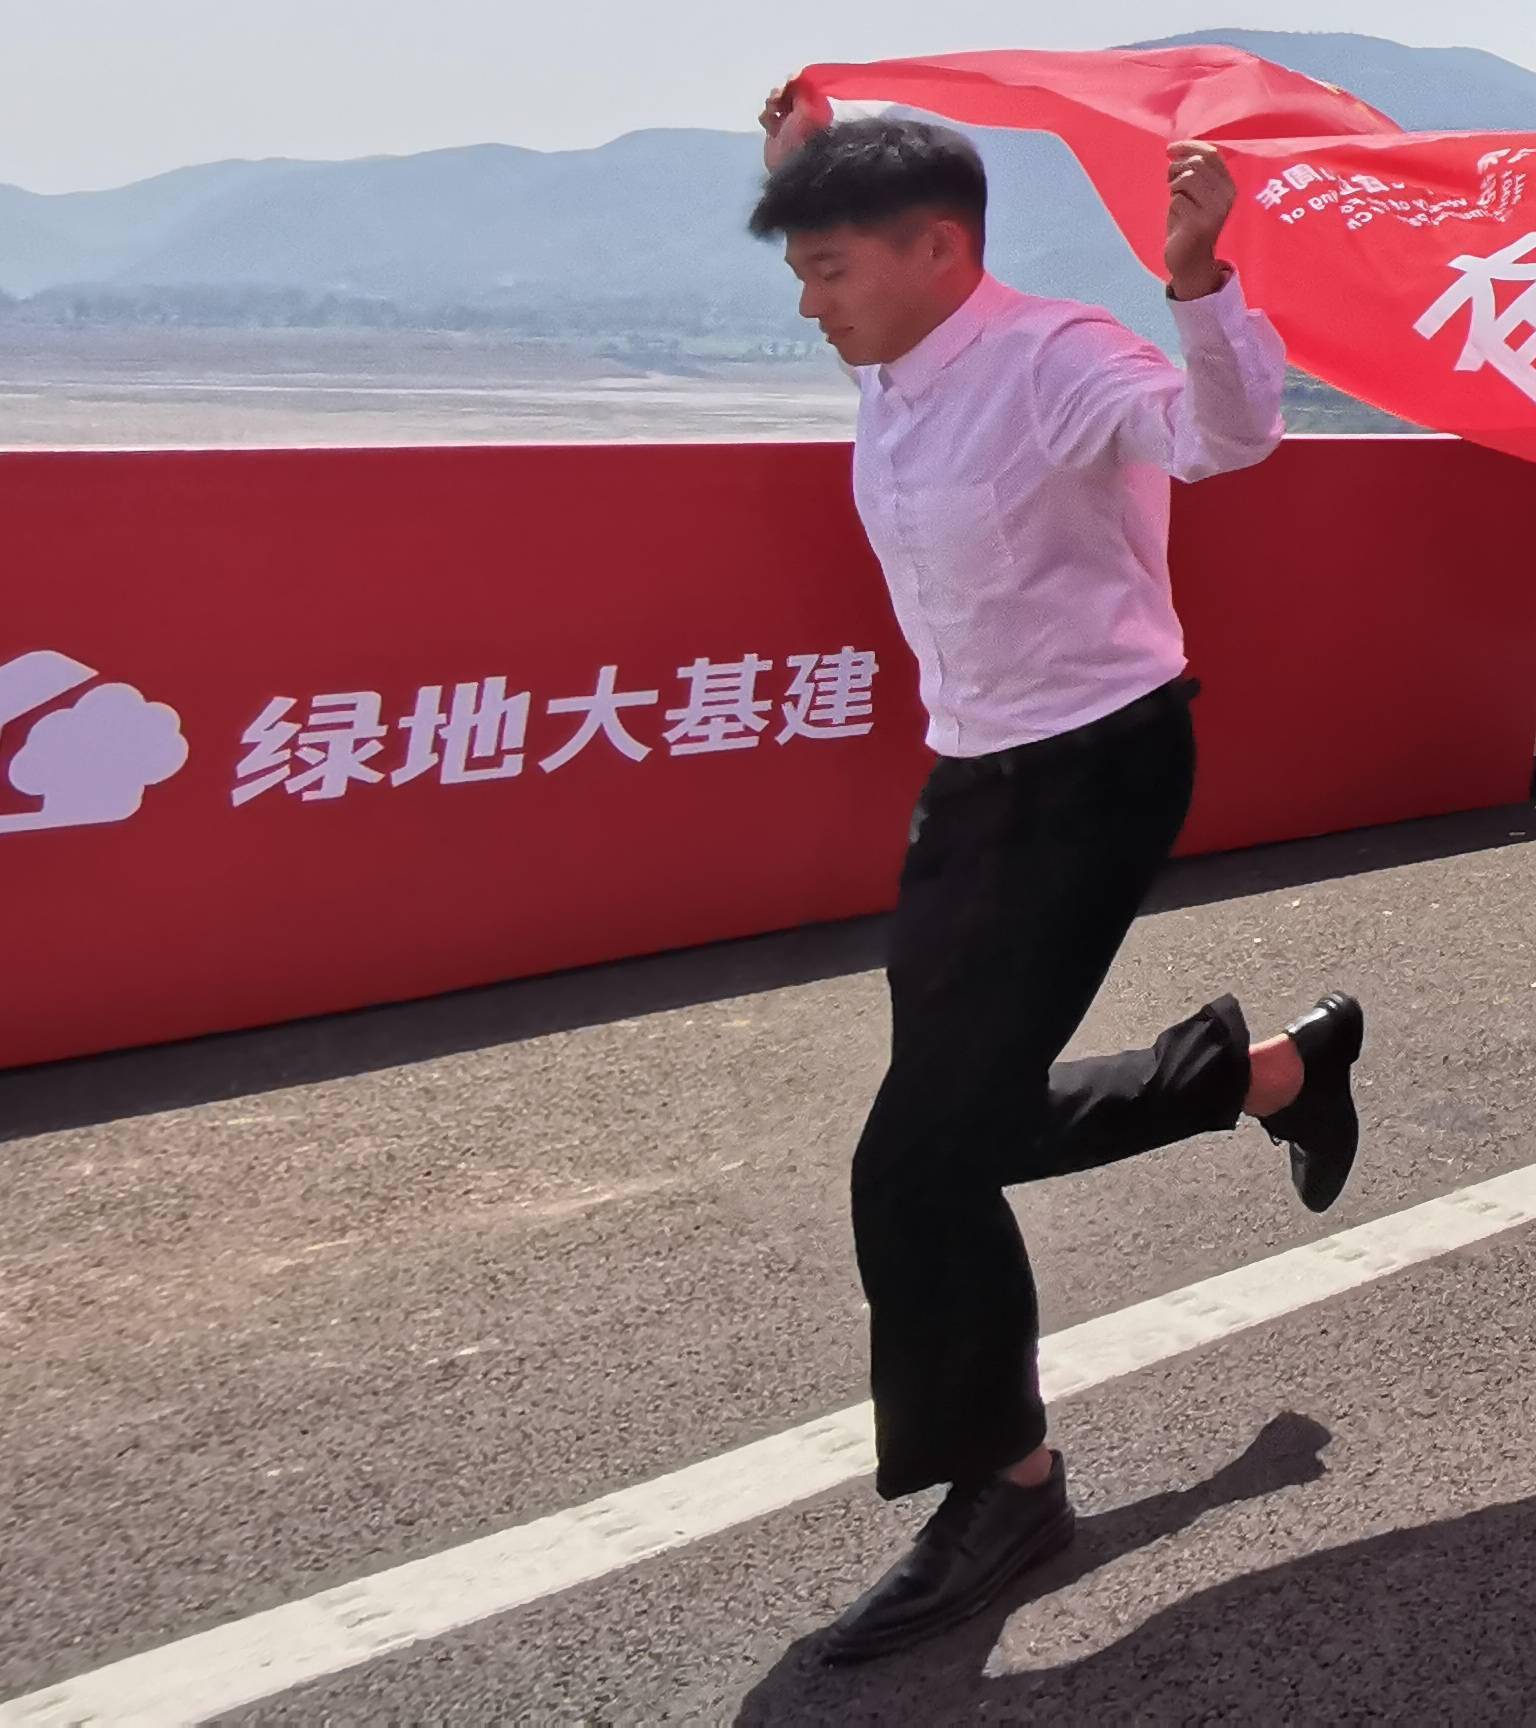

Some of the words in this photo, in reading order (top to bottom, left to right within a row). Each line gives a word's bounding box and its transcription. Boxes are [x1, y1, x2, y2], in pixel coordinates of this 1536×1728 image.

[231, 645, 881, 808] 绿地大基建
